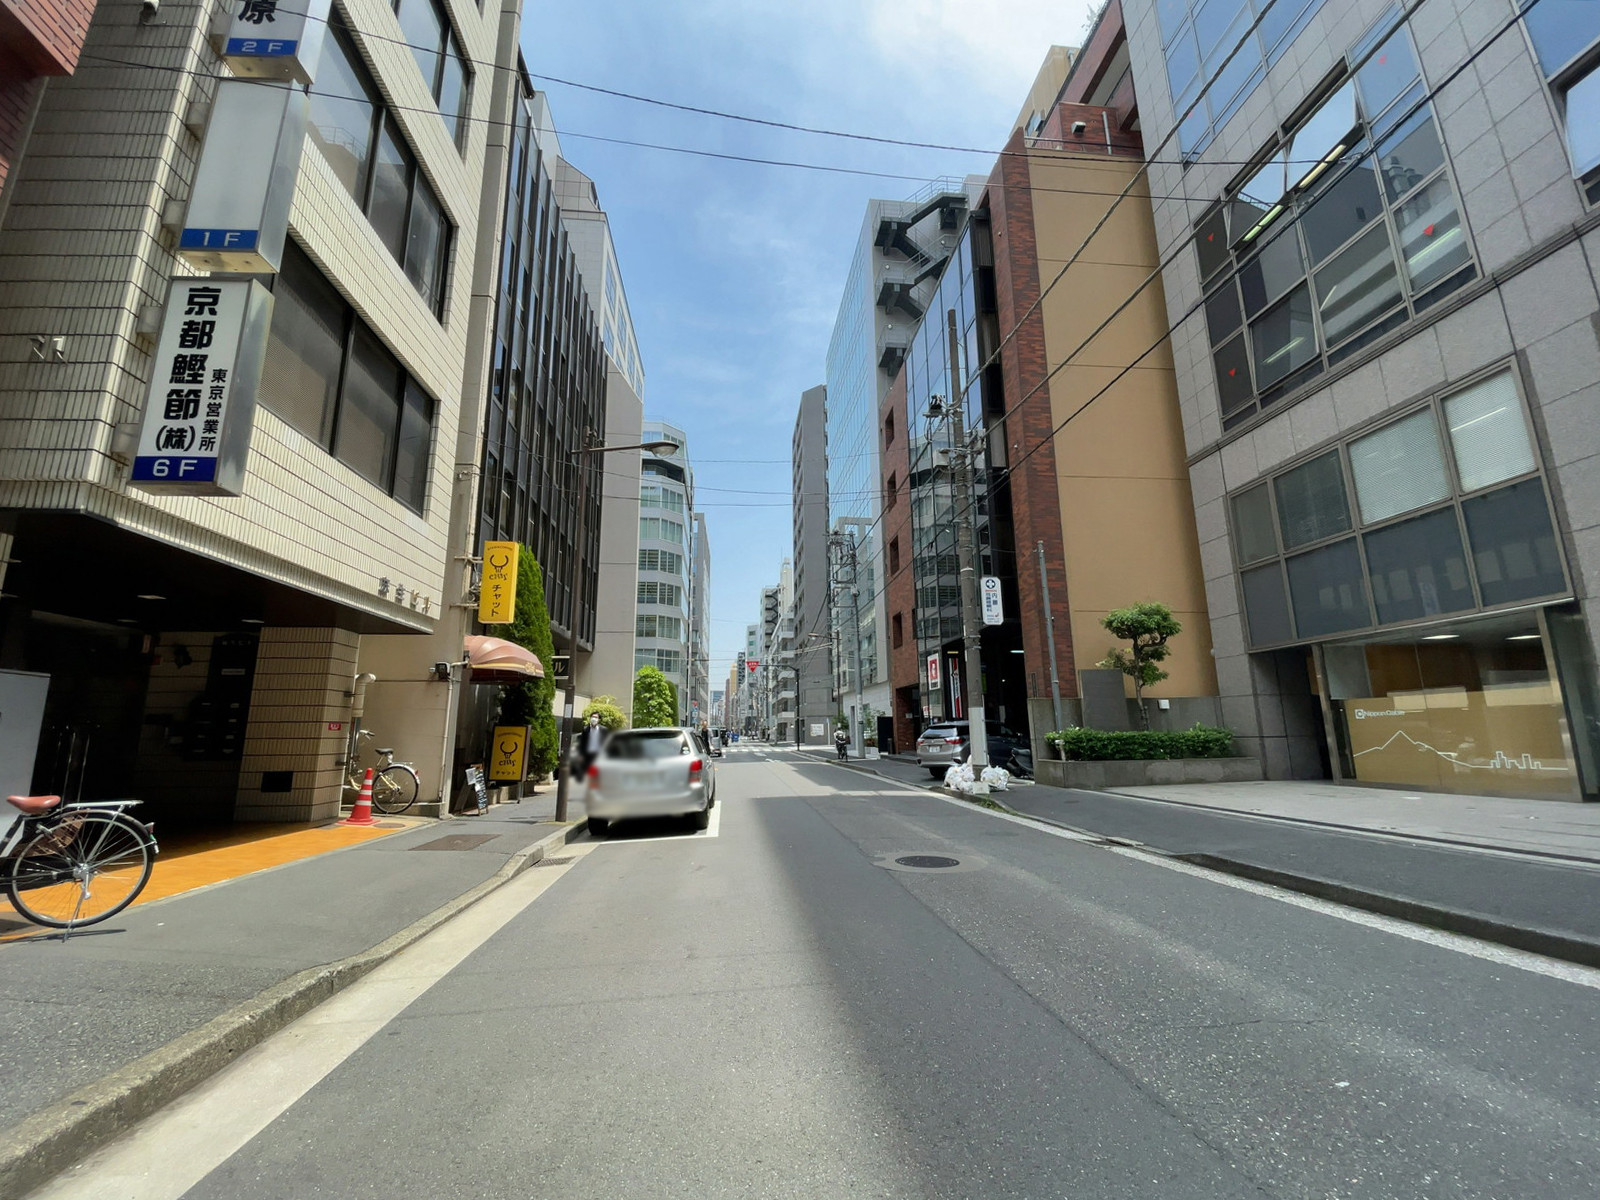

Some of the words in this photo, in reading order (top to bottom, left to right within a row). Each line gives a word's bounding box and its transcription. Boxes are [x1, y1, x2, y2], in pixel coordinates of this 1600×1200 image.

[198, 368, 229, 452] 東京営業所
[491, 584, 502, 618] チャット
